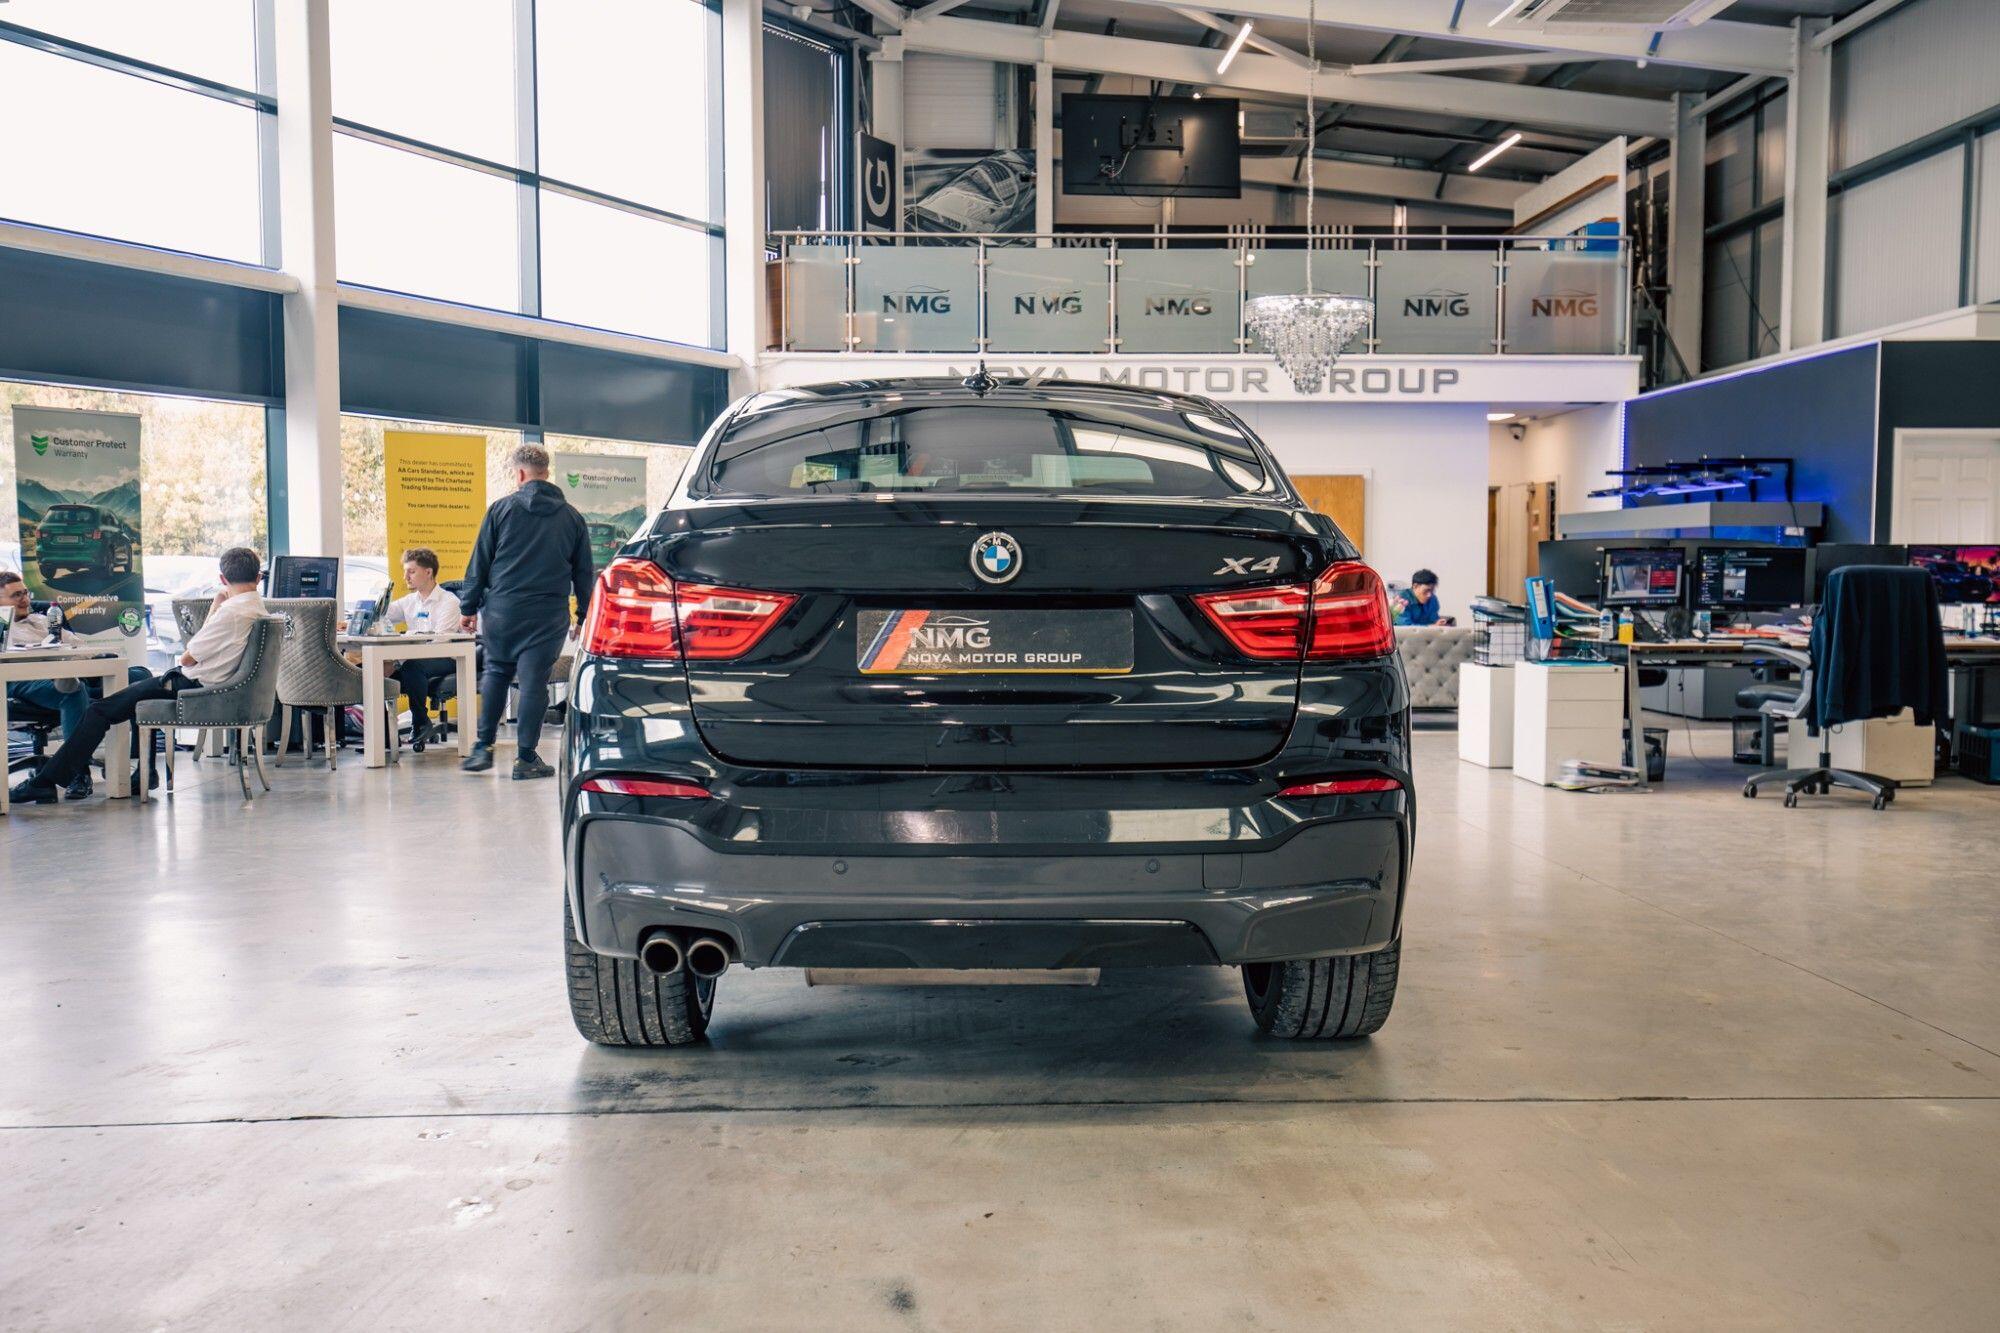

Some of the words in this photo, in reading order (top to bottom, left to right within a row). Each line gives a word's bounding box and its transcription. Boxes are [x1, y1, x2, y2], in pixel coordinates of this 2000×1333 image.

[882, 294, 951, 314] NMG
[1014, 296, 1082, 315] NMG
[1144, 297, 1213, 316] NMG
[1403, 298, 1470, 317] NMG
[1531, 298, 1598, 317] NMG
[1100, 366, 1270, 393] MOTOR
[53, 437, 94, 447] Customer
[96, 439, 127, 449] Protect
[54, 448, 88, 459] Warranty
[582, 474, 613, 482] Customer
[1213, 556, 1280, 575] X4
[57, 594, 119, 603] Comprehensive
[70, 606, 107, 615] Warranty
[908, 626, 992, 650] NMG
[907, 652, 952, 664] NOYA
[959, 652, 1018, 664] MOTOR
[1024, 652, 1082, 664] GROUP
